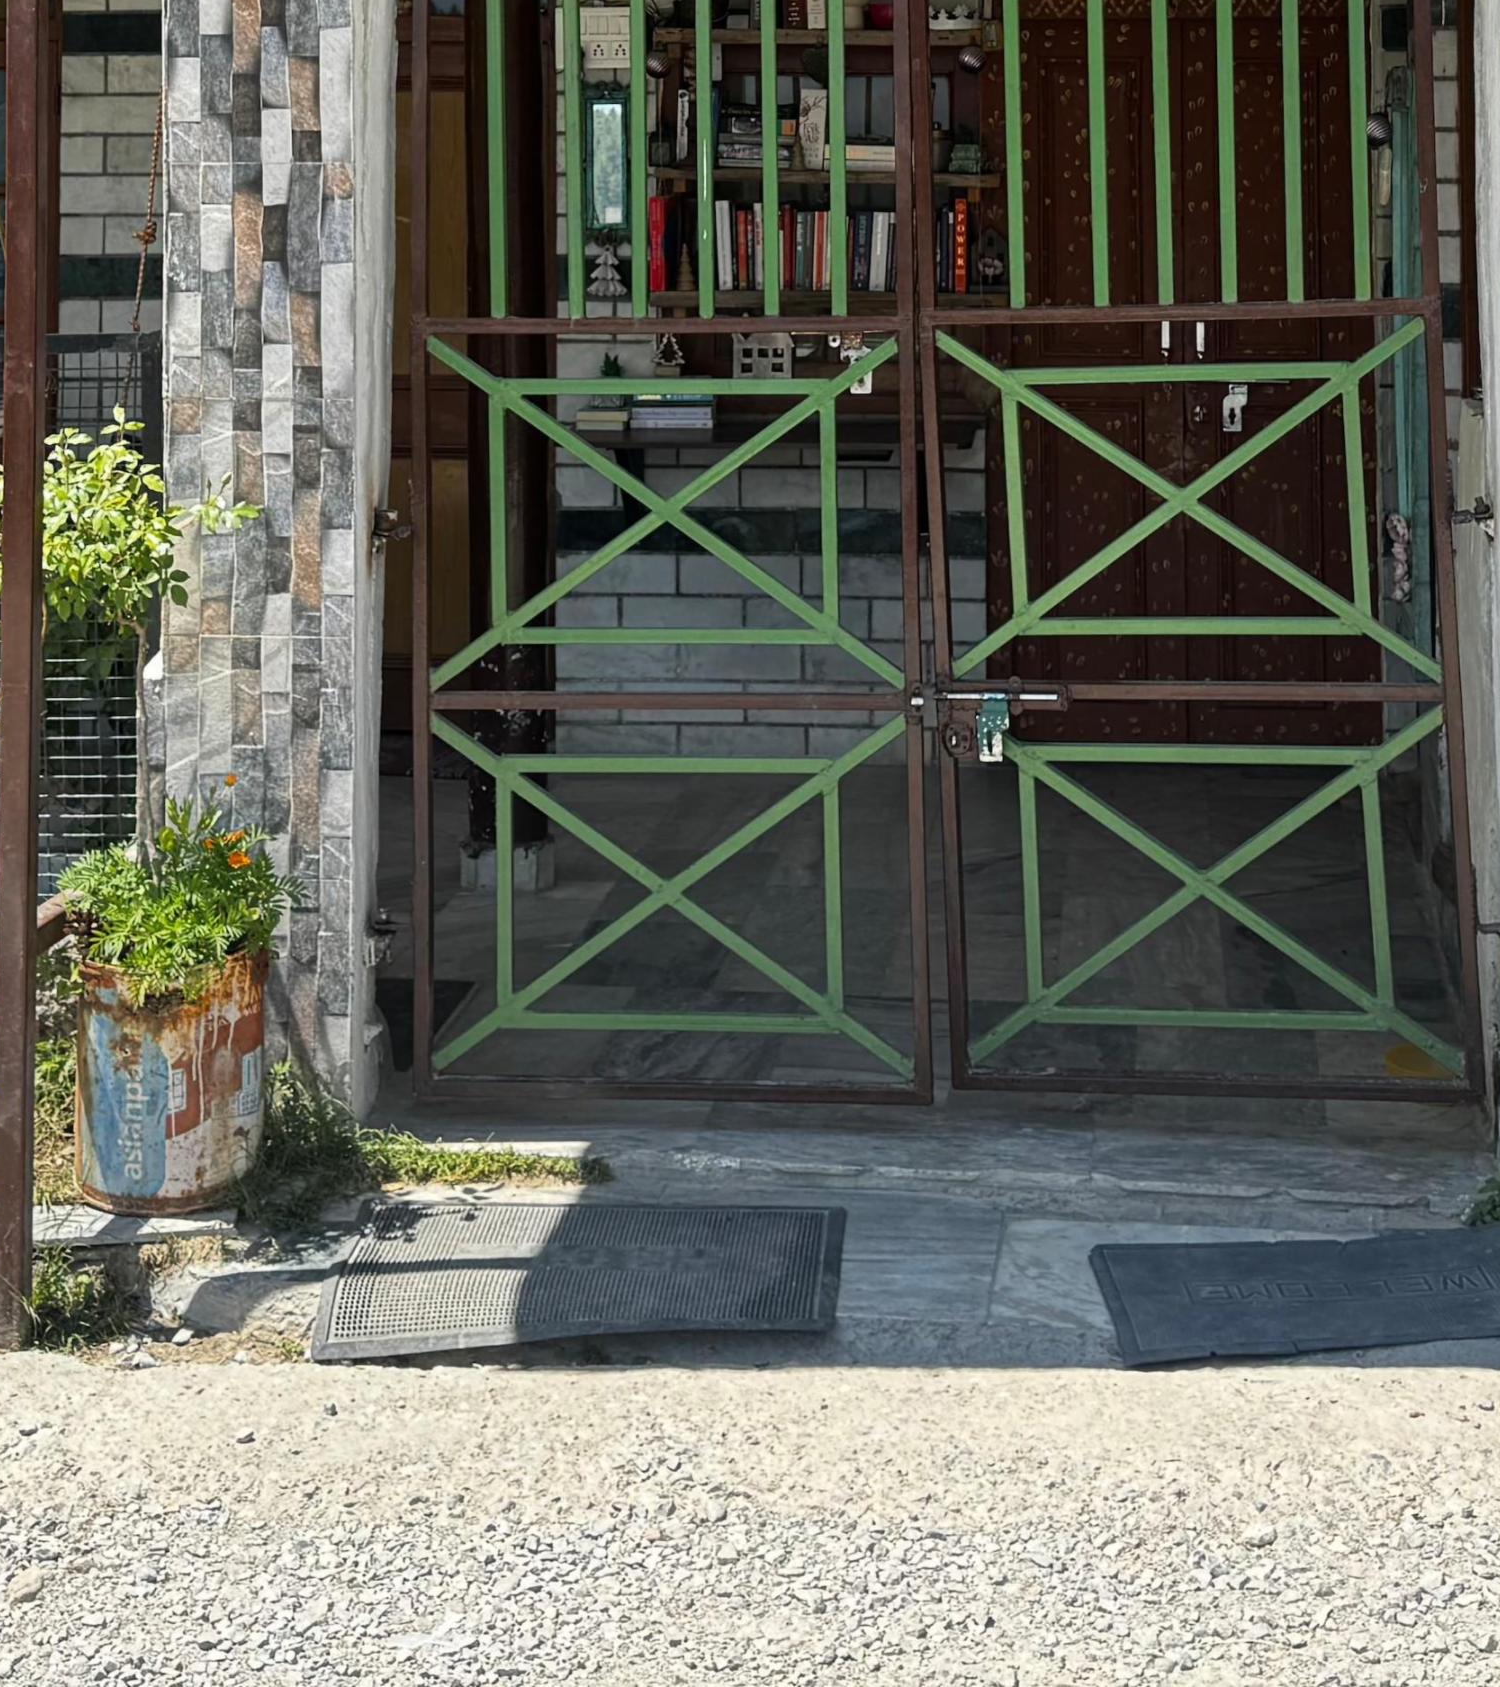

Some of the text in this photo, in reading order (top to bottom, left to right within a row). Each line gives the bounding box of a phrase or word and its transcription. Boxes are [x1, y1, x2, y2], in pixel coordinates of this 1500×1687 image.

[956, 213, 966, 266] POWER
[118, 1064, 149, 1180] asianpa
[1200, 1269, 1479, 1301] WELCOME
